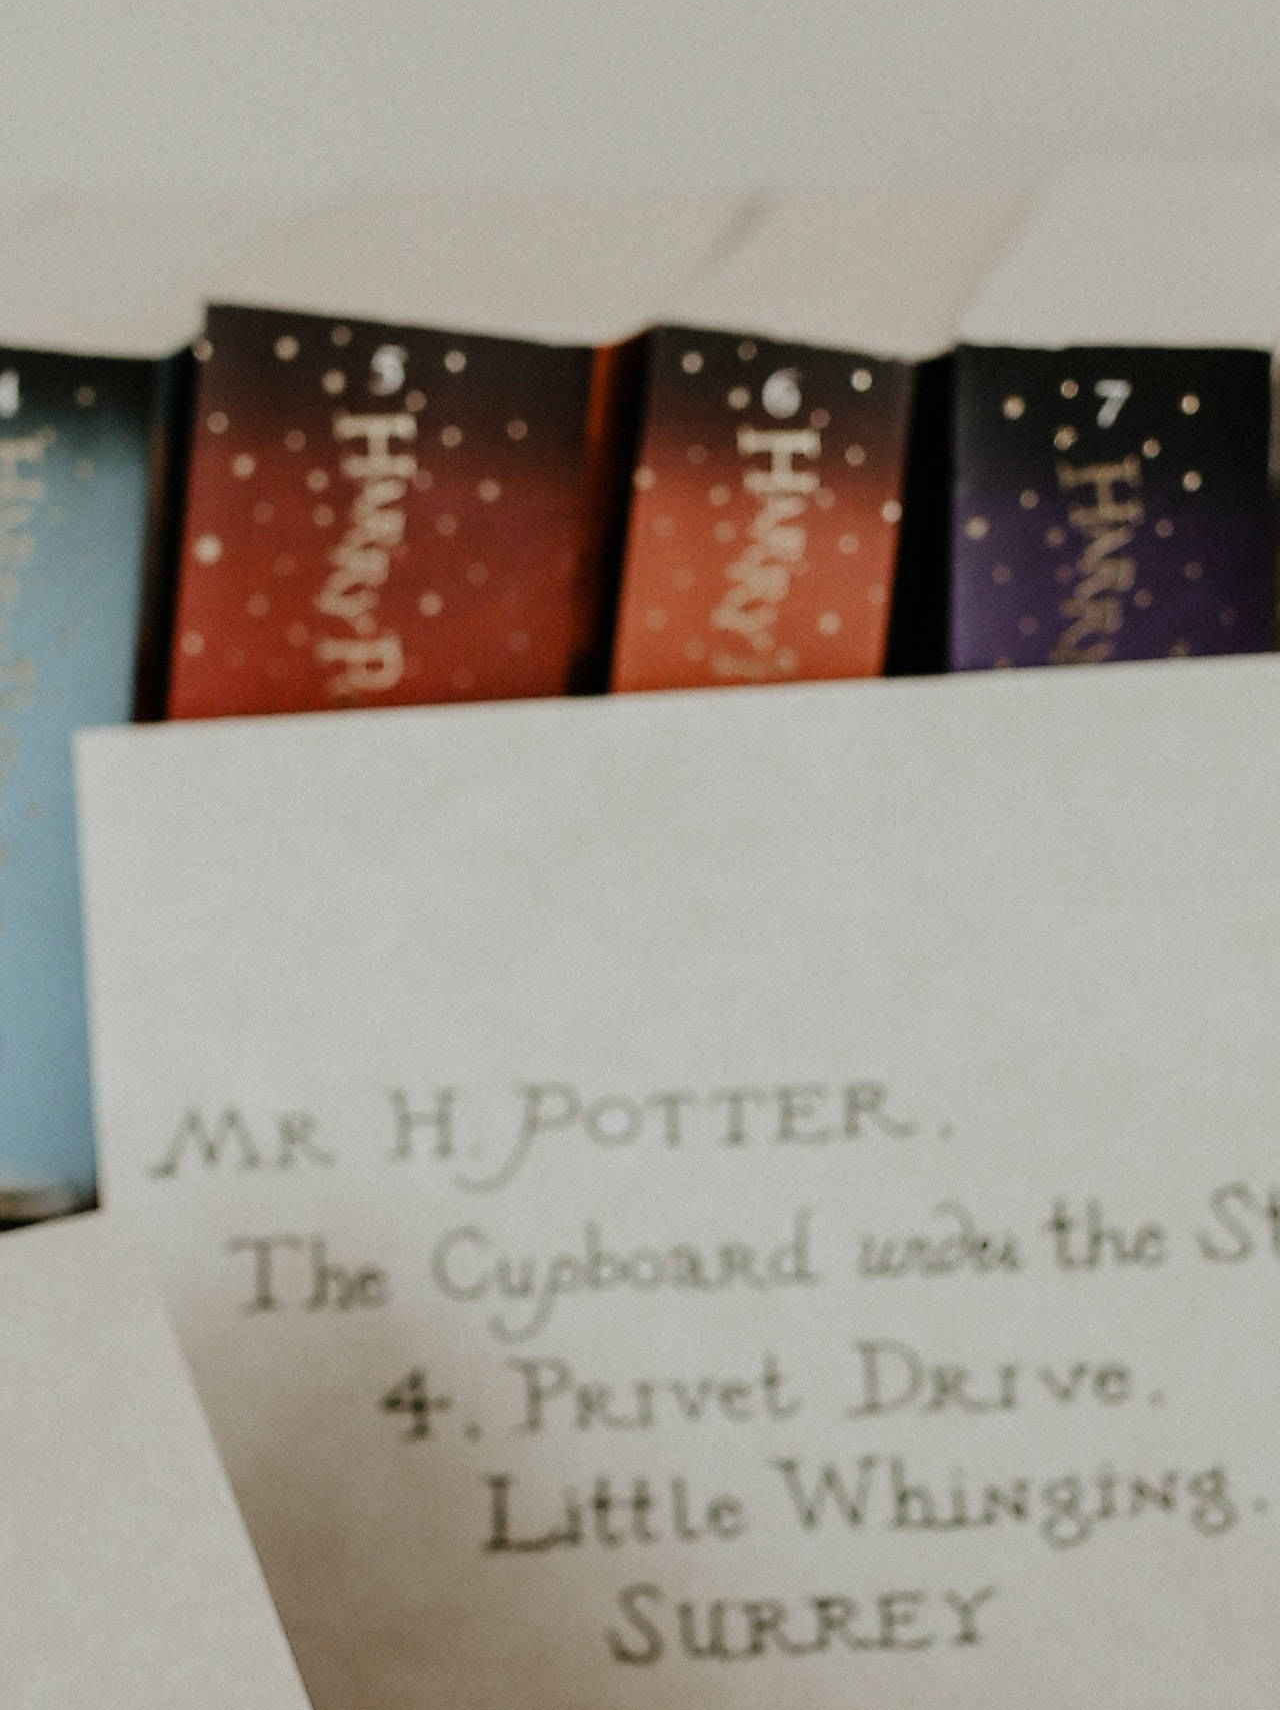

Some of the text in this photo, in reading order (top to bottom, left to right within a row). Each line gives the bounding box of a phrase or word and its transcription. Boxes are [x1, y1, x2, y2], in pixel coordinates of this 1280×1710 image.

[370, 343, 408, 396] 5
[762, 366, 803, 420] 6
[1094, 378, 1133, 428] 7
[226, 1232, 390, 1314] The
[429, 1204, 818, 1344] Cupboard
[1044, 1195, 1168, 1271] the
[481, 1472, 748, 1555] Little
[606, 1583, 1002, 1666] SURREY
